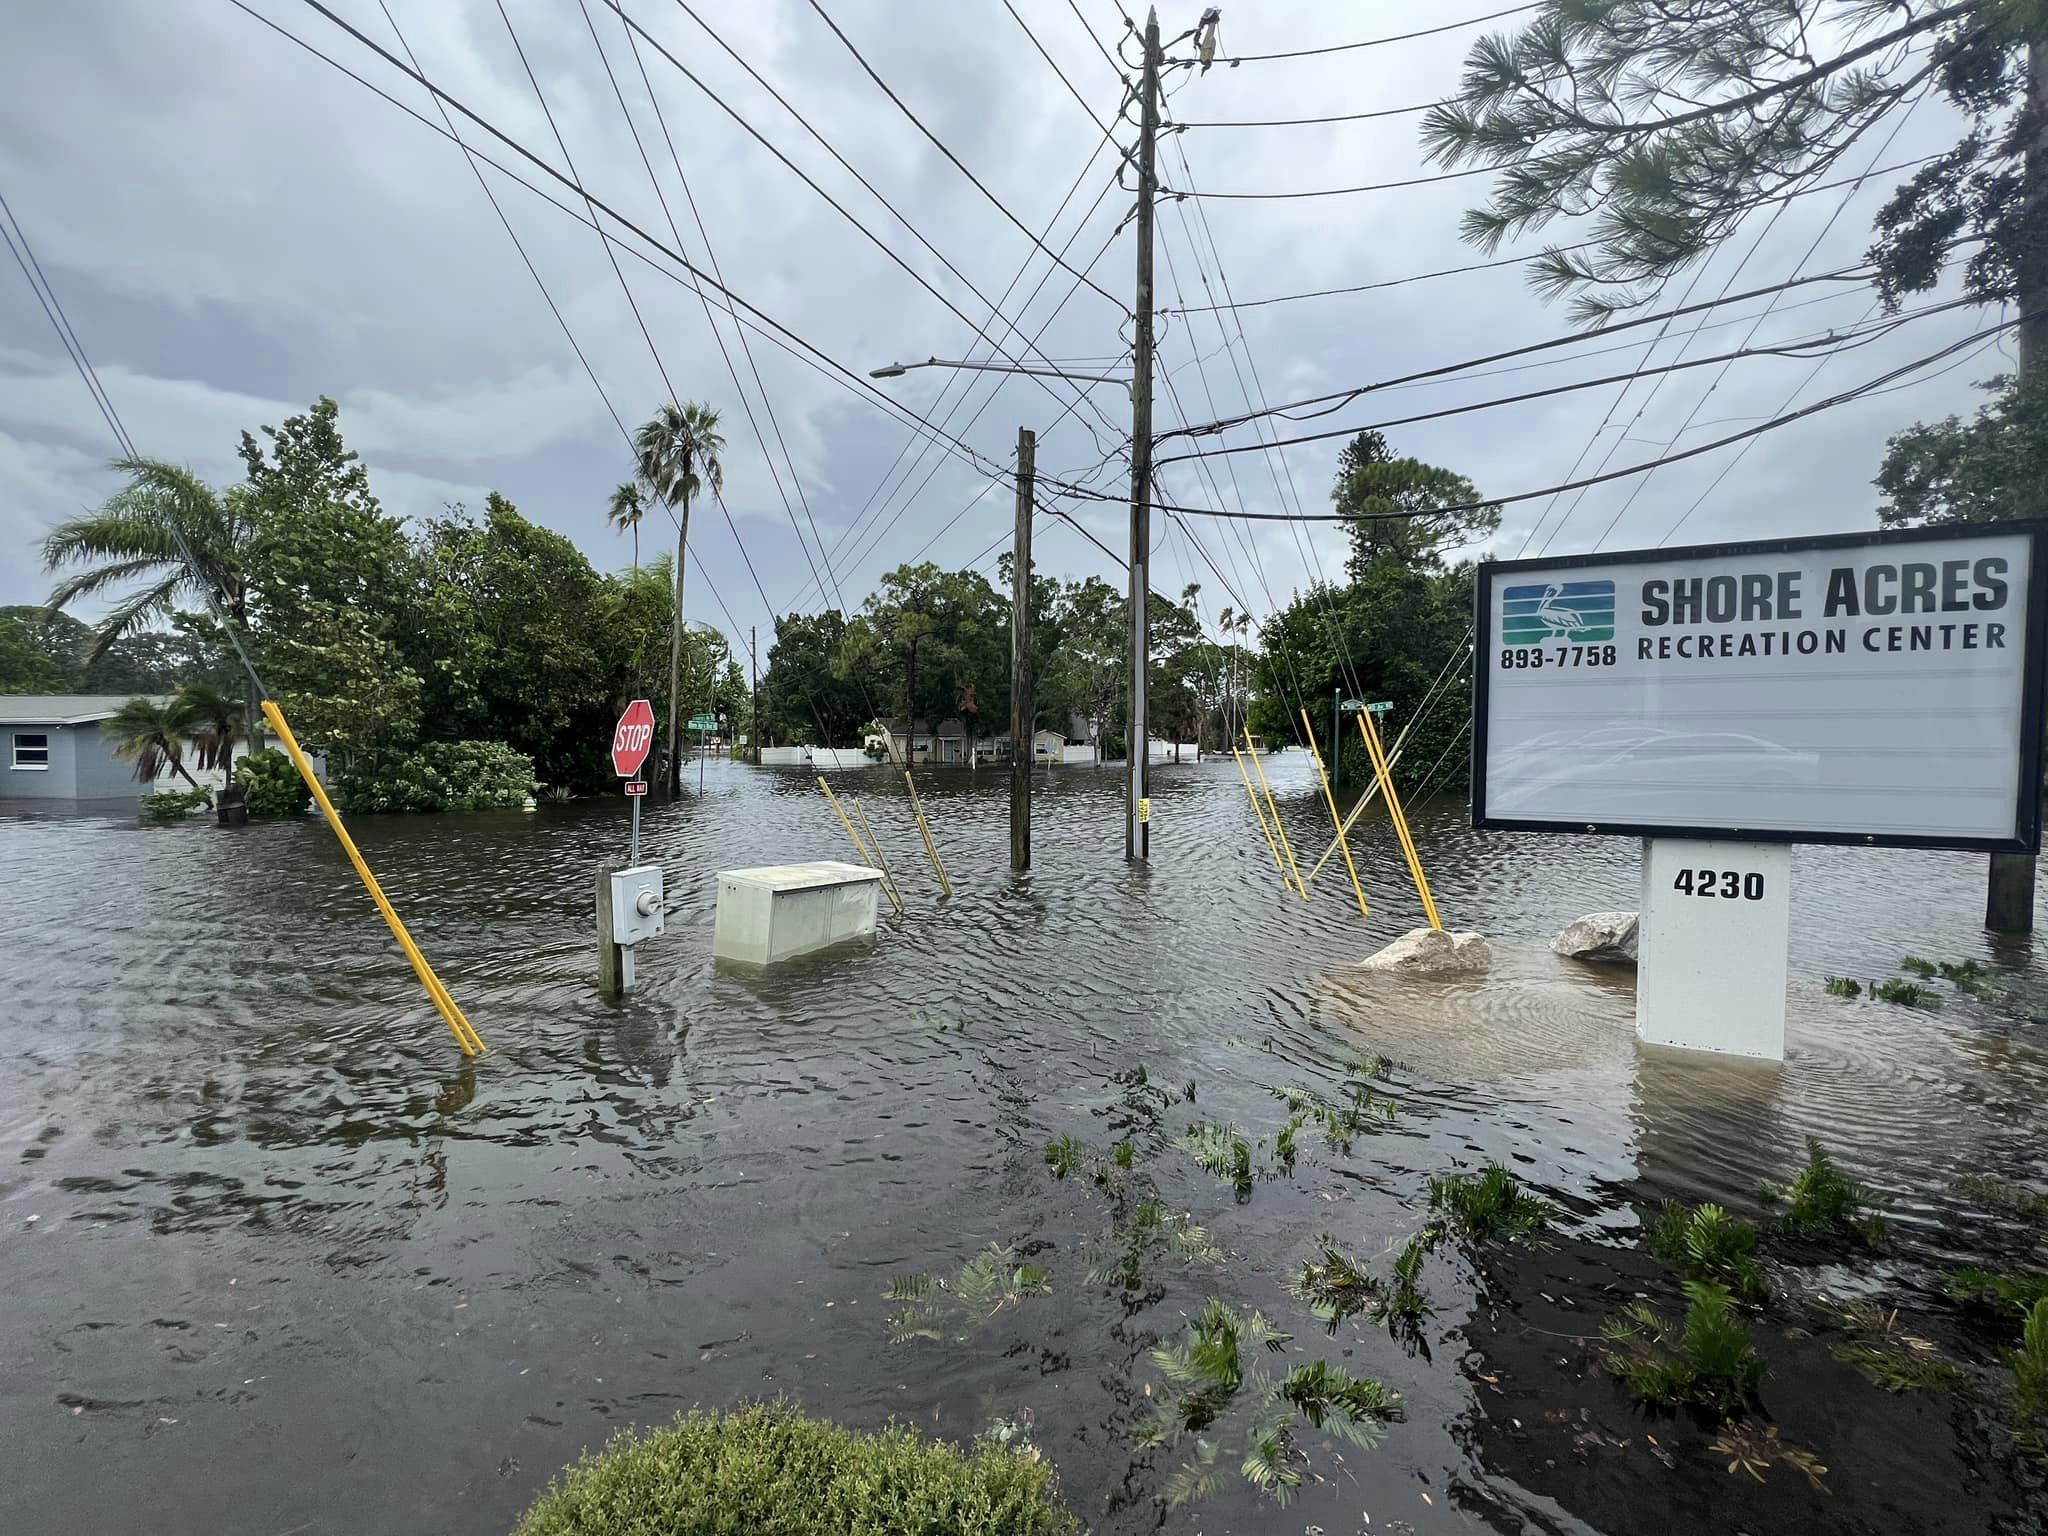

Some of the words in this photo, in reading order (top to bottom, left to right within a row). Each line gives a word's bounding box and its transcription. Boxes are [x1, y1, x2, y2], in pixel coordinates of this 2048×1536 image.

[1641, 571, 1803, 627] SHORE
[1823, 557, 2009, 618] ACRES
[1638, 629, 1846, 660] RECREATION
[1863, 623, 2006, 652] CENTER
[1501, 645, 1616, 669] 893-7758
[616, 724, 650, 752] STOP
[627, 784, 636, 793] ALL
[636, 784, 645, 792] WAY
[1674, 868, 1765, 900] 4230
